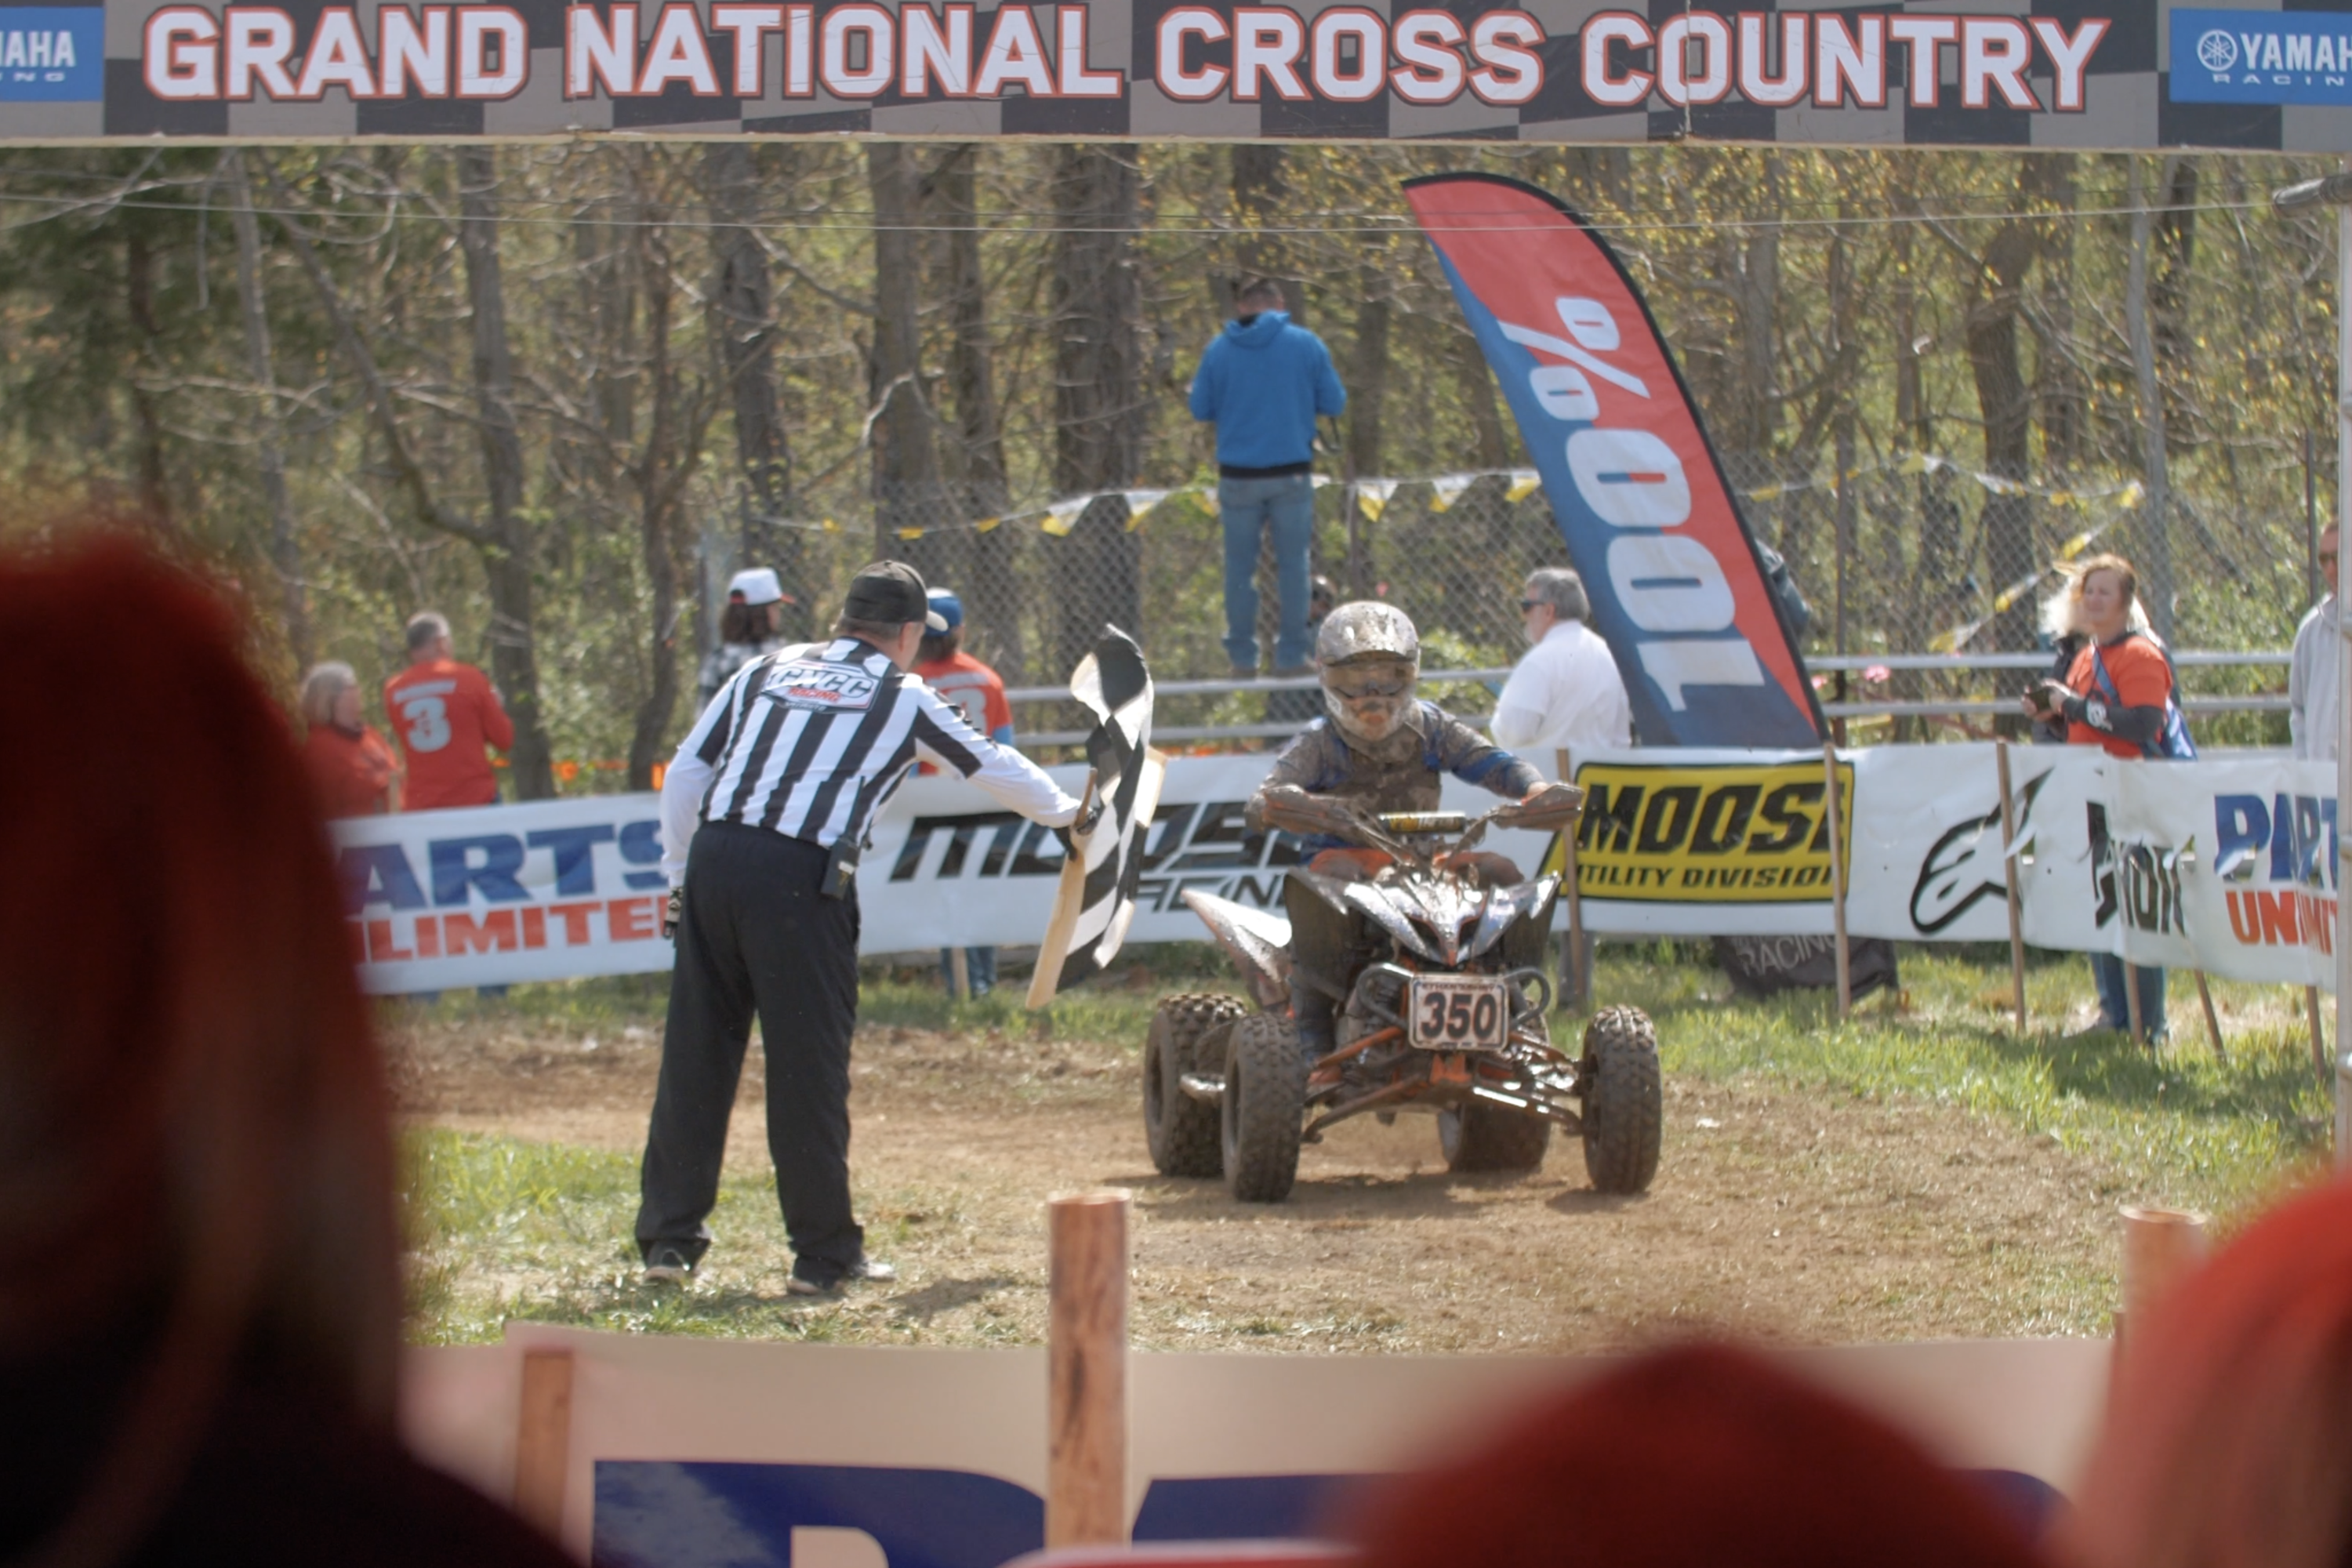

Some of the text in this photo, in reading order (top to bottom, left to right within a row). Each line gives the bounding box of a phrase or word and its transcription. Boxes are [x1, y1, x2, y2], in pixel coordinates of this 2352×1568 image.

[0, 30, 76, 67] AHA
[143, 4, 2111, 111] GRAND NATIONAL CROSS COUNTRY
[1496, 296, 1766, 711] 100%
[402, 696, 452, 753] 3
[345, 895, 670, 964] LIMITE
[1421, 992, 1497, 1041] 350
